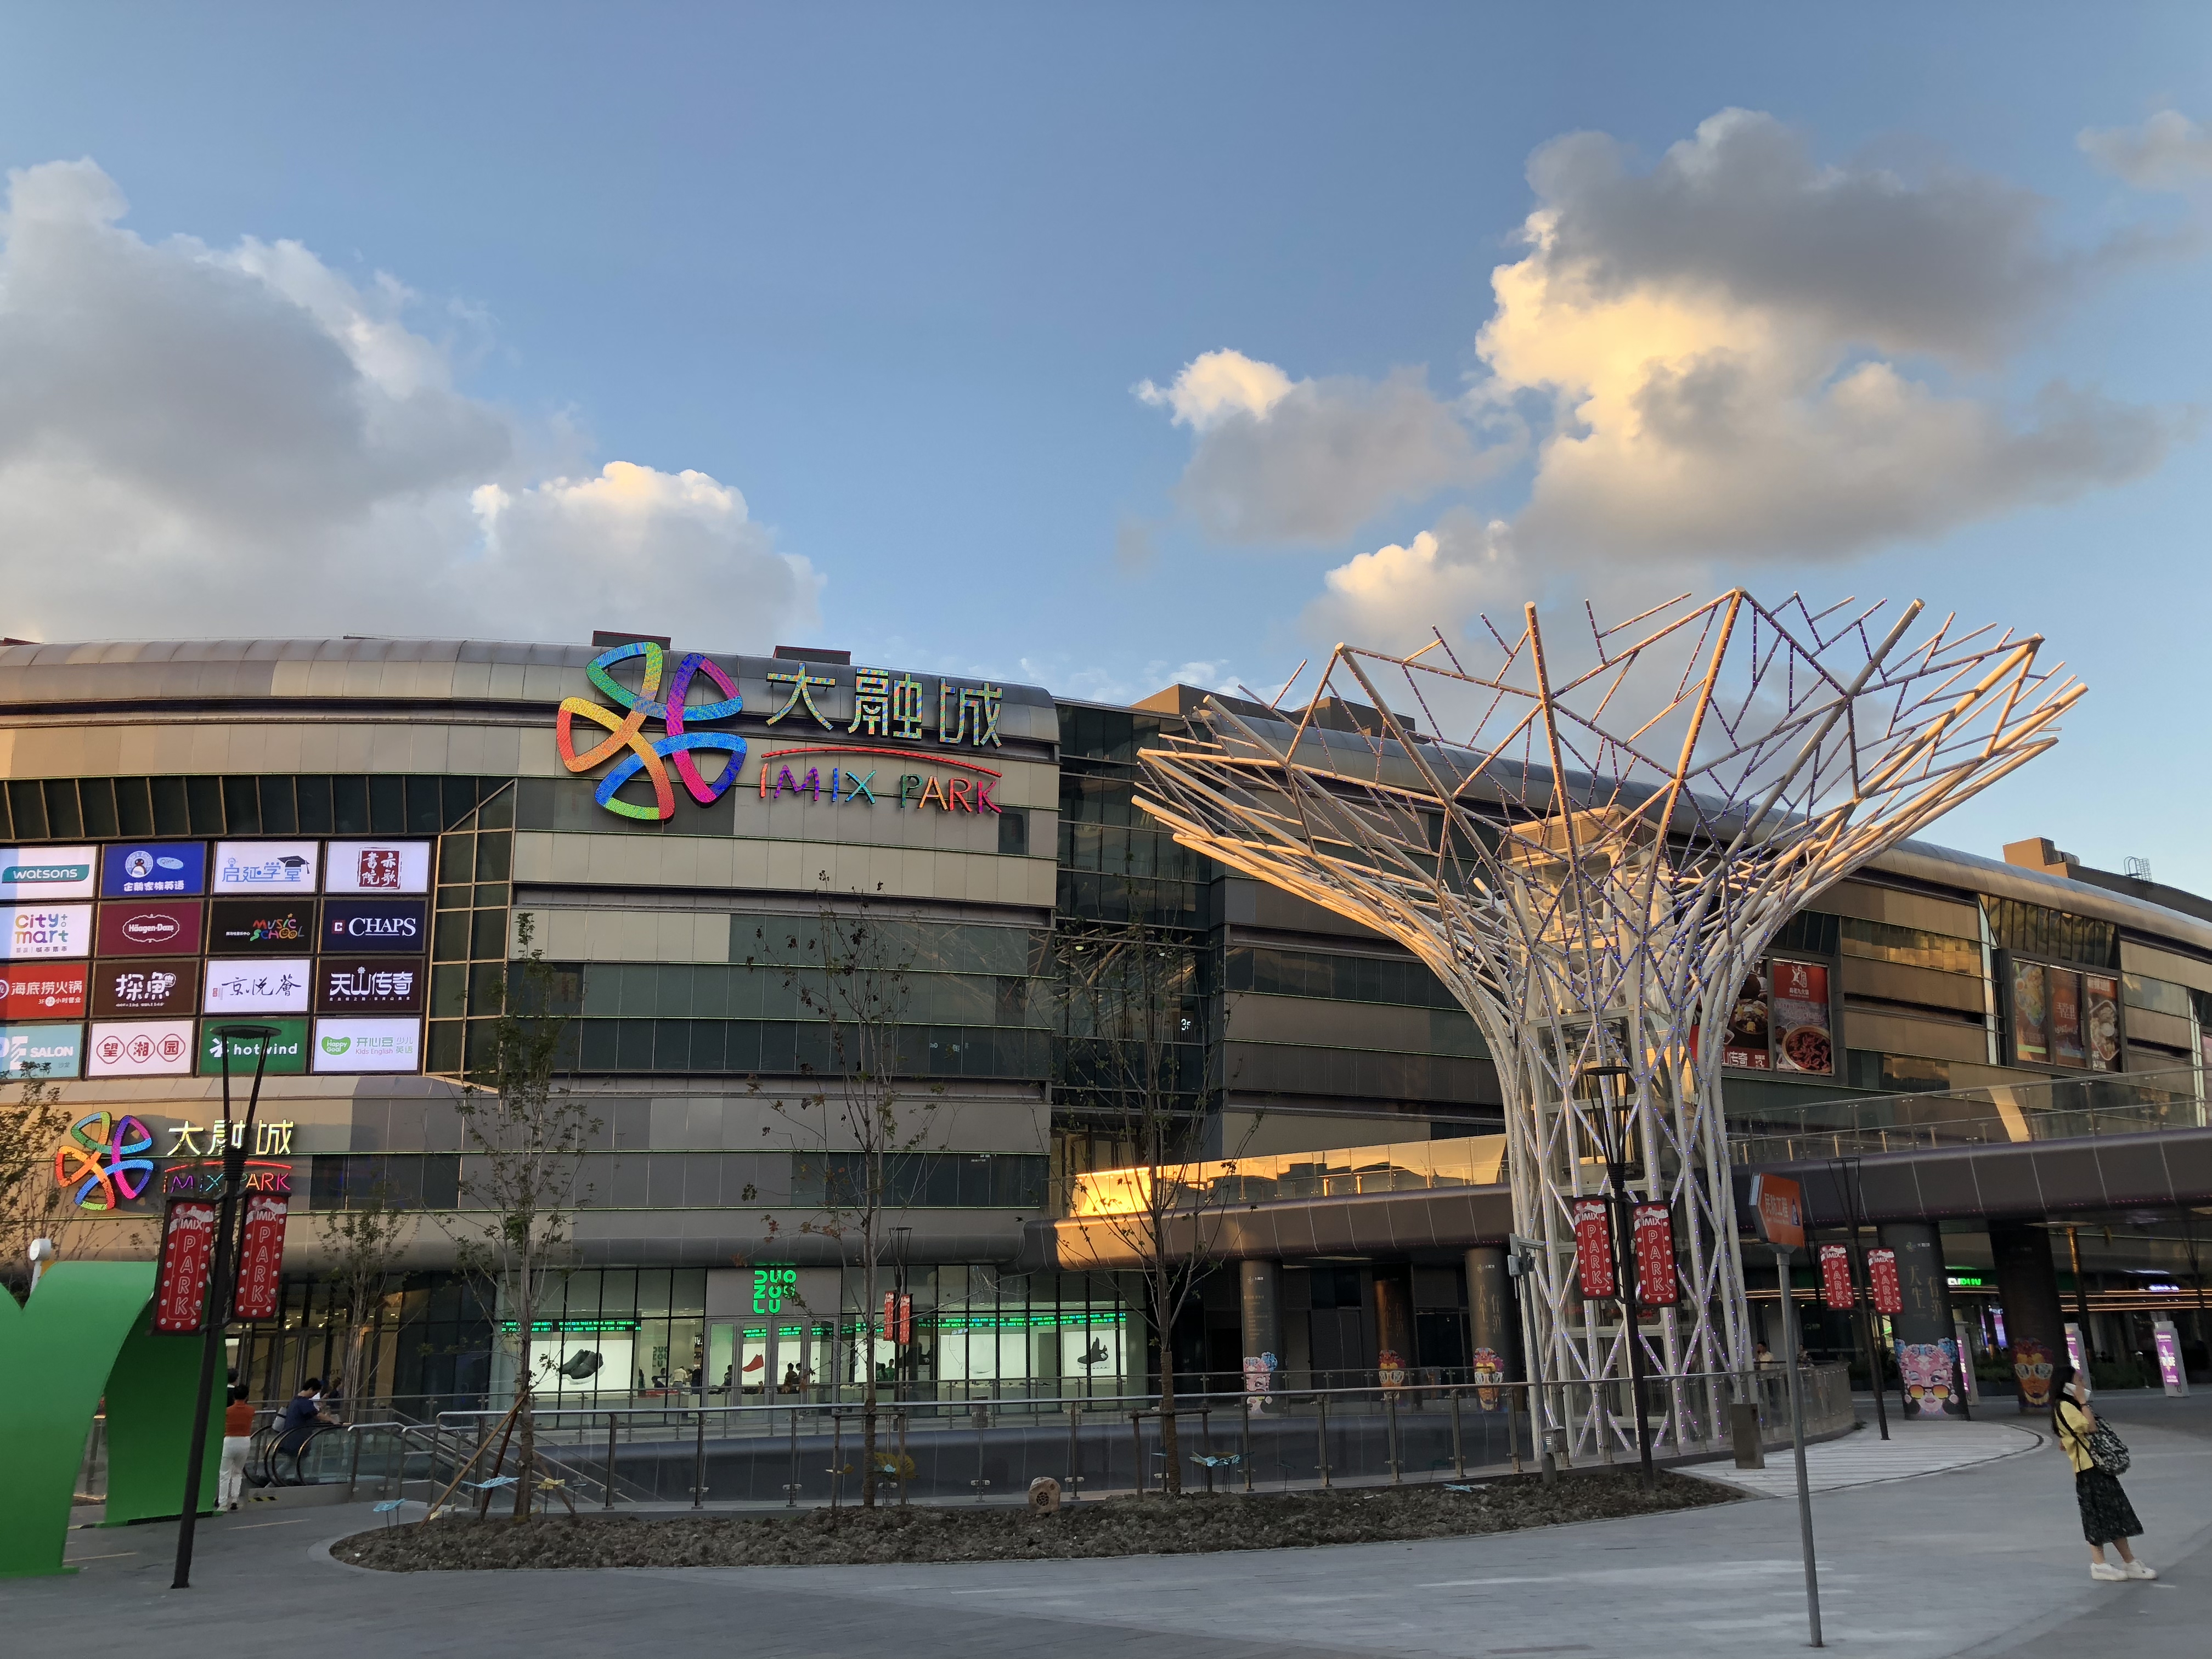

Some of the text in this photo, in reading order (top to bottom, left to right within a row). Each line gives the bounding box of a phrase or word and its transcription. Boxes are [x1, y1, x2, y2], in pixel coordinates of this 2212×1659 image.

[766, 662, 1003, 748] 大融城
[760, 762, 1003, 814] IMIX PARK
[13, 868, 78, 879] watsons
[123, 880, 184, 892] 企鹅家族英语
[129, 924, 174, 934] Häagen-Dazs
[250, 926, 305, 941] SCHOOL
[348, 917, 416, 937] CHAPS
[15, 930, 69, 944] mart
[10, 980, 83, 996] 海底捞火锅
[329, 970, 414, 996] 天山传奇
[1181, 1018, 1191, 1031] 3F
[326, 1039, 348, 1048] Happy
[356, 1037, 393, 1047] 开心豆
[396, 1036, 413, 1045] 少儿
[30, 1046, 74, 1058] SALON
[103, 1040, 179, 1057] 望湘园
[396, 1045, 413, 1054] 英语
[1764, 1192, 1789, 1218] 民防工程
[256, 1210, 277, 1222] IMIX
[1581, 1212, 1599, 1221] IMIX
[1641, 1217, 1662, 1227] IMIX
[179, 1218, 204, 1231] IMIX
[1587, 1224, 1602, 1284] PARK
[1647, 1229, 1664, 1291] PARK
[251, 1226, 271, 1303] PARK
[173, 1235, 196, 1316] PARK
[754, 1269, 797, 1284] DUO
[1831, 1260, 1844, 1301] PARK
[1878, 1265, 1893, 1306] PARK
[753, 1299, 781, 1314] LU
